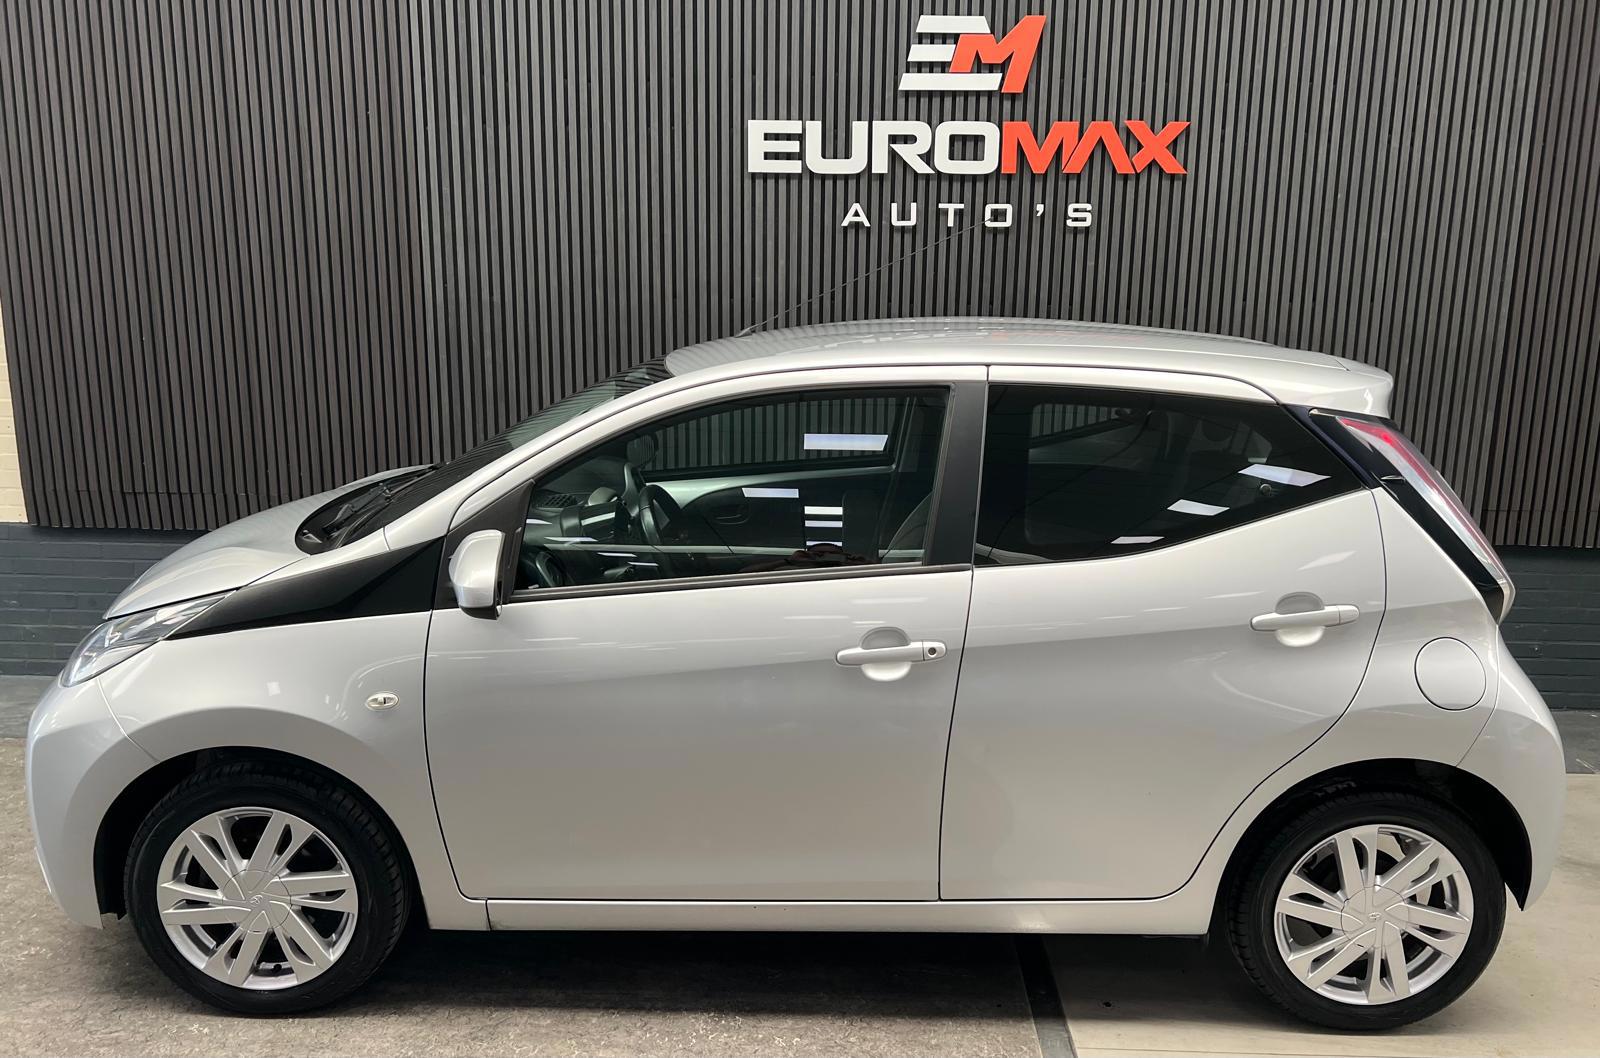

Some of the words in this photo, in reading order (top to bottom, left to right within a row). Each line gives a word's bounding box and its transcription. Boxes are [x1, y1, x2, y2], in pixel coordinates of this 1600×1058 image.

[898, 15, 1047, 93] EM
[747, 119, 1190, 175] EUROMAX
[841, 202, 1093, 228] AUTO'S
